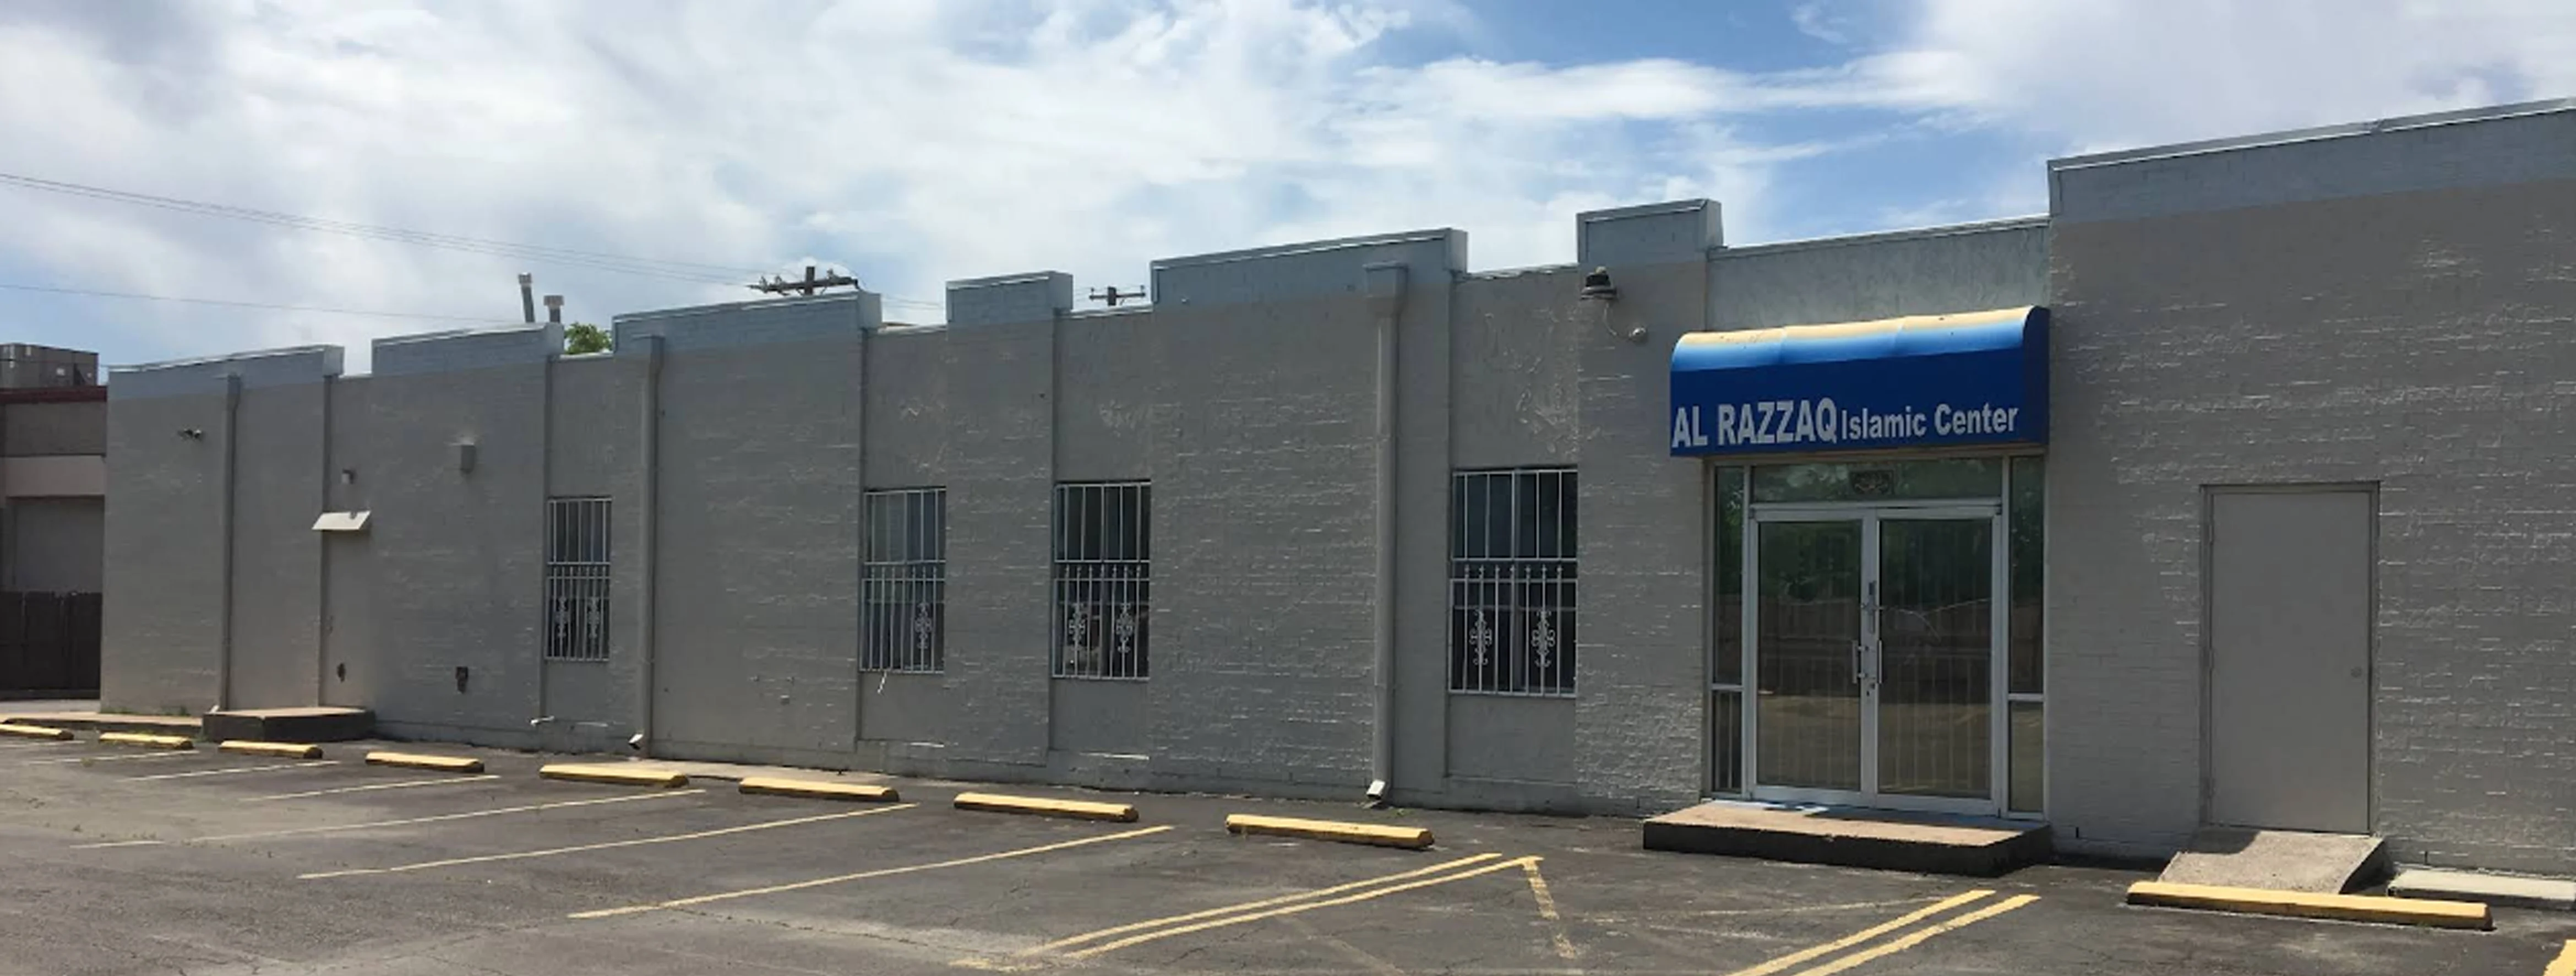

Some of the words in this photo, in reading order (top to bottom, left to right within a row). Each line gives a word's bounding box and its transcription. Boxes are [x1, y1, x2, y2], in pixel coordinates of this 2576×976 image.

[1671, 406, 1708, 447] AL
[1718, 398, 1837, 445] RAZZAQ
[1842, 406, 1927, 440] Islamic
[1934, 403, 2019, 436] Center
